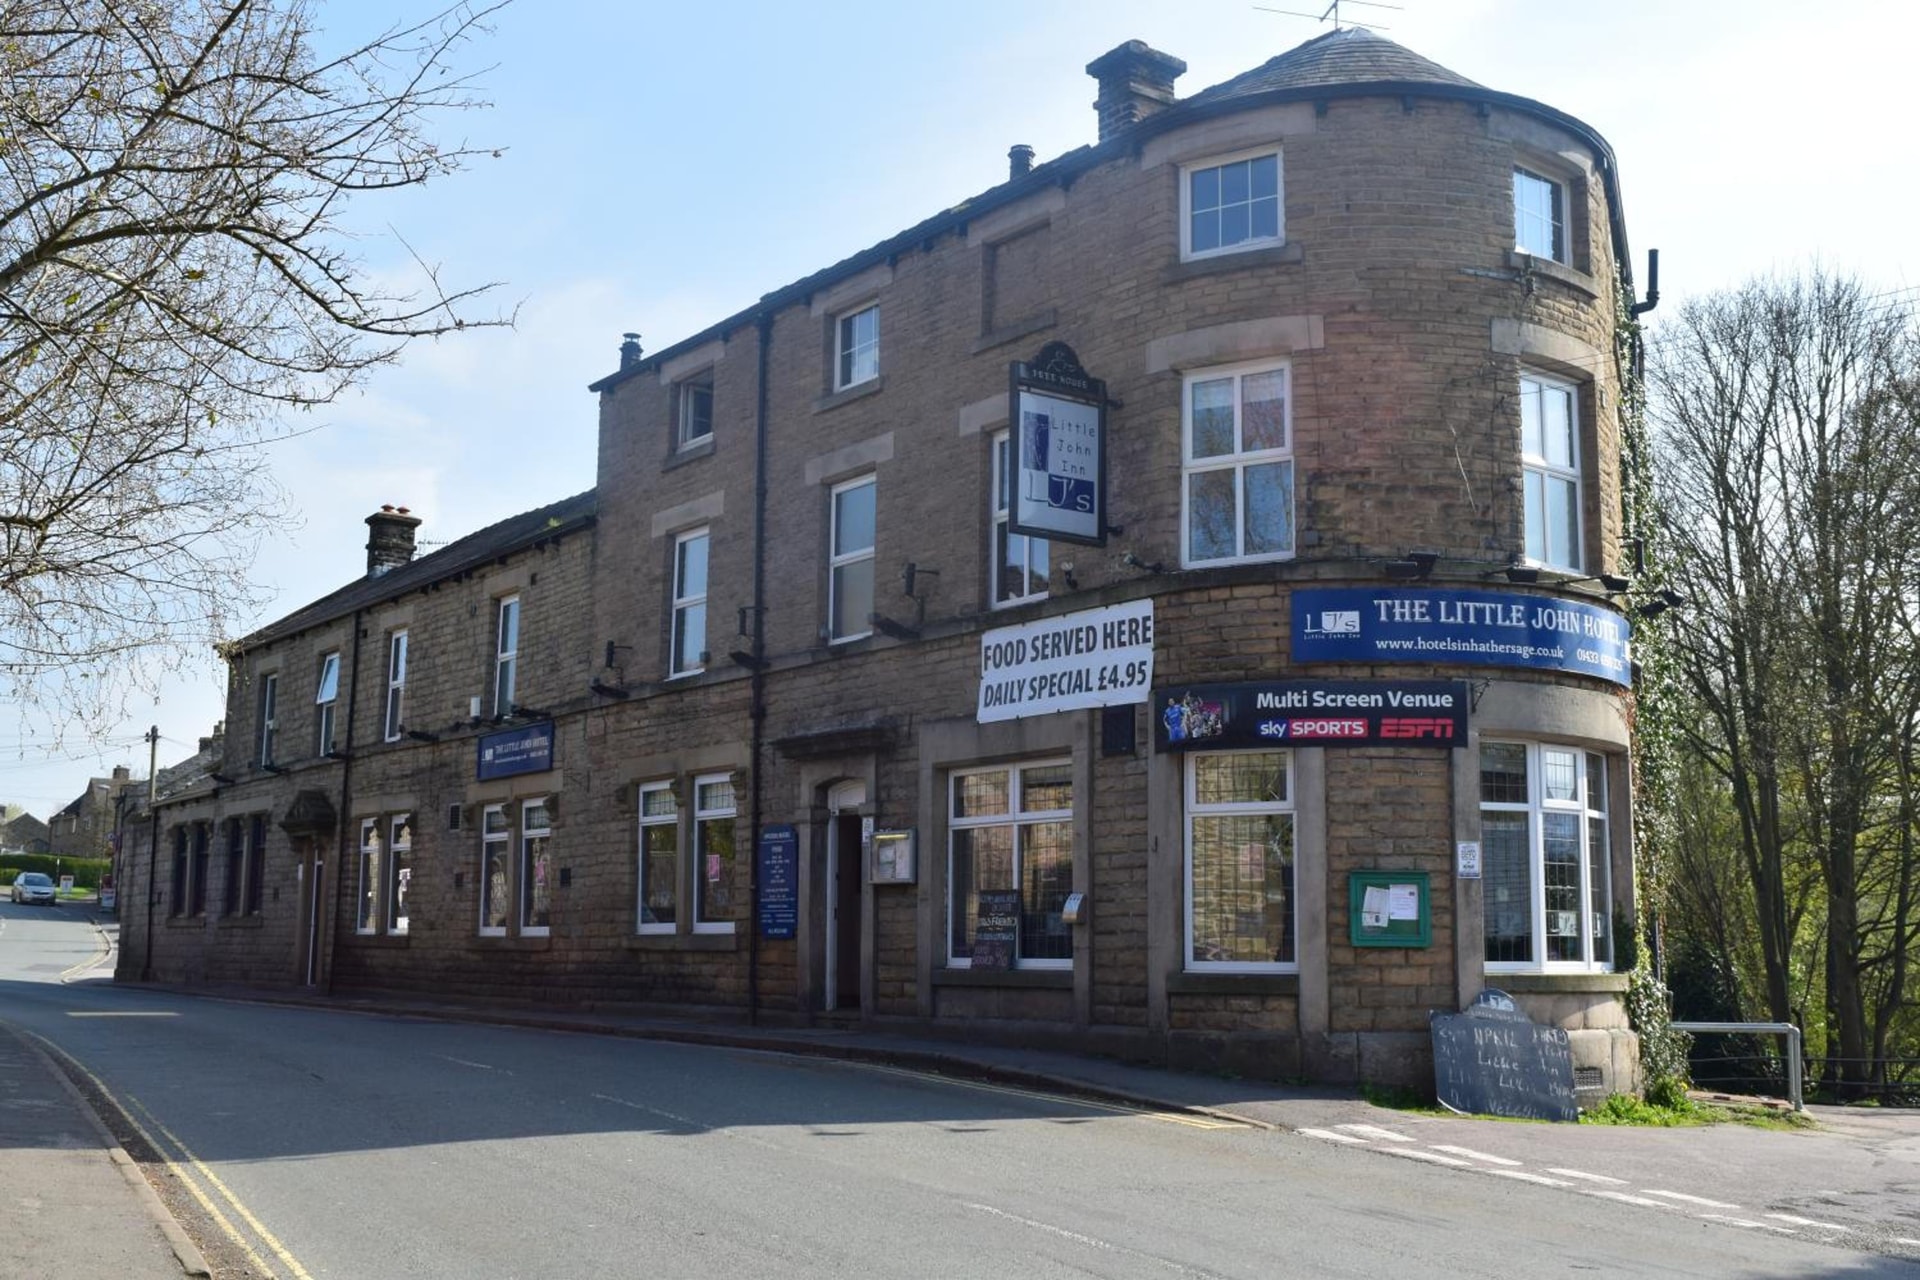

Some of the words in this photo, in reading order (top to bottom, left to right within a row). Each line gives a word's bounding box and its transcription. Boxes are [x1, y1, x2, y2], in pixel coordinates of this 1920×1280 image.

[1051, 415, 1096, 438] Little
[1057, 439, 1091, 457] John
[1062, 460, 1086, 475] Inn
[1374, 599, 1432, 624] THE
[1439, 601, 1527, 628] LITTLE
[1532, 607, 1580, 635] JOHN
[984, 638, 1026, 671] FOOD
[1030, 624, 1098, 663] SERVED
[1102, 615, 1152, 650] HERE
[1376, 637, 1564, 660] www.hotelsinhathersage.co.uk
[983, 678, 1026, 709] DAILY
[1028, 668, 1093, 701] SPECIAL
[1098, 660, 1147, 691] £4.95
[1256, 691, 1308, 709] Multi
[1312, 691, 1383, 708] Screen
[1387, 691, 1454, 708] Venue
[1260, 720, 1287, 738] sky
[1291, 720, 1365, 736] SPORTS
[1380, 719, 1454, 738] ESPN
